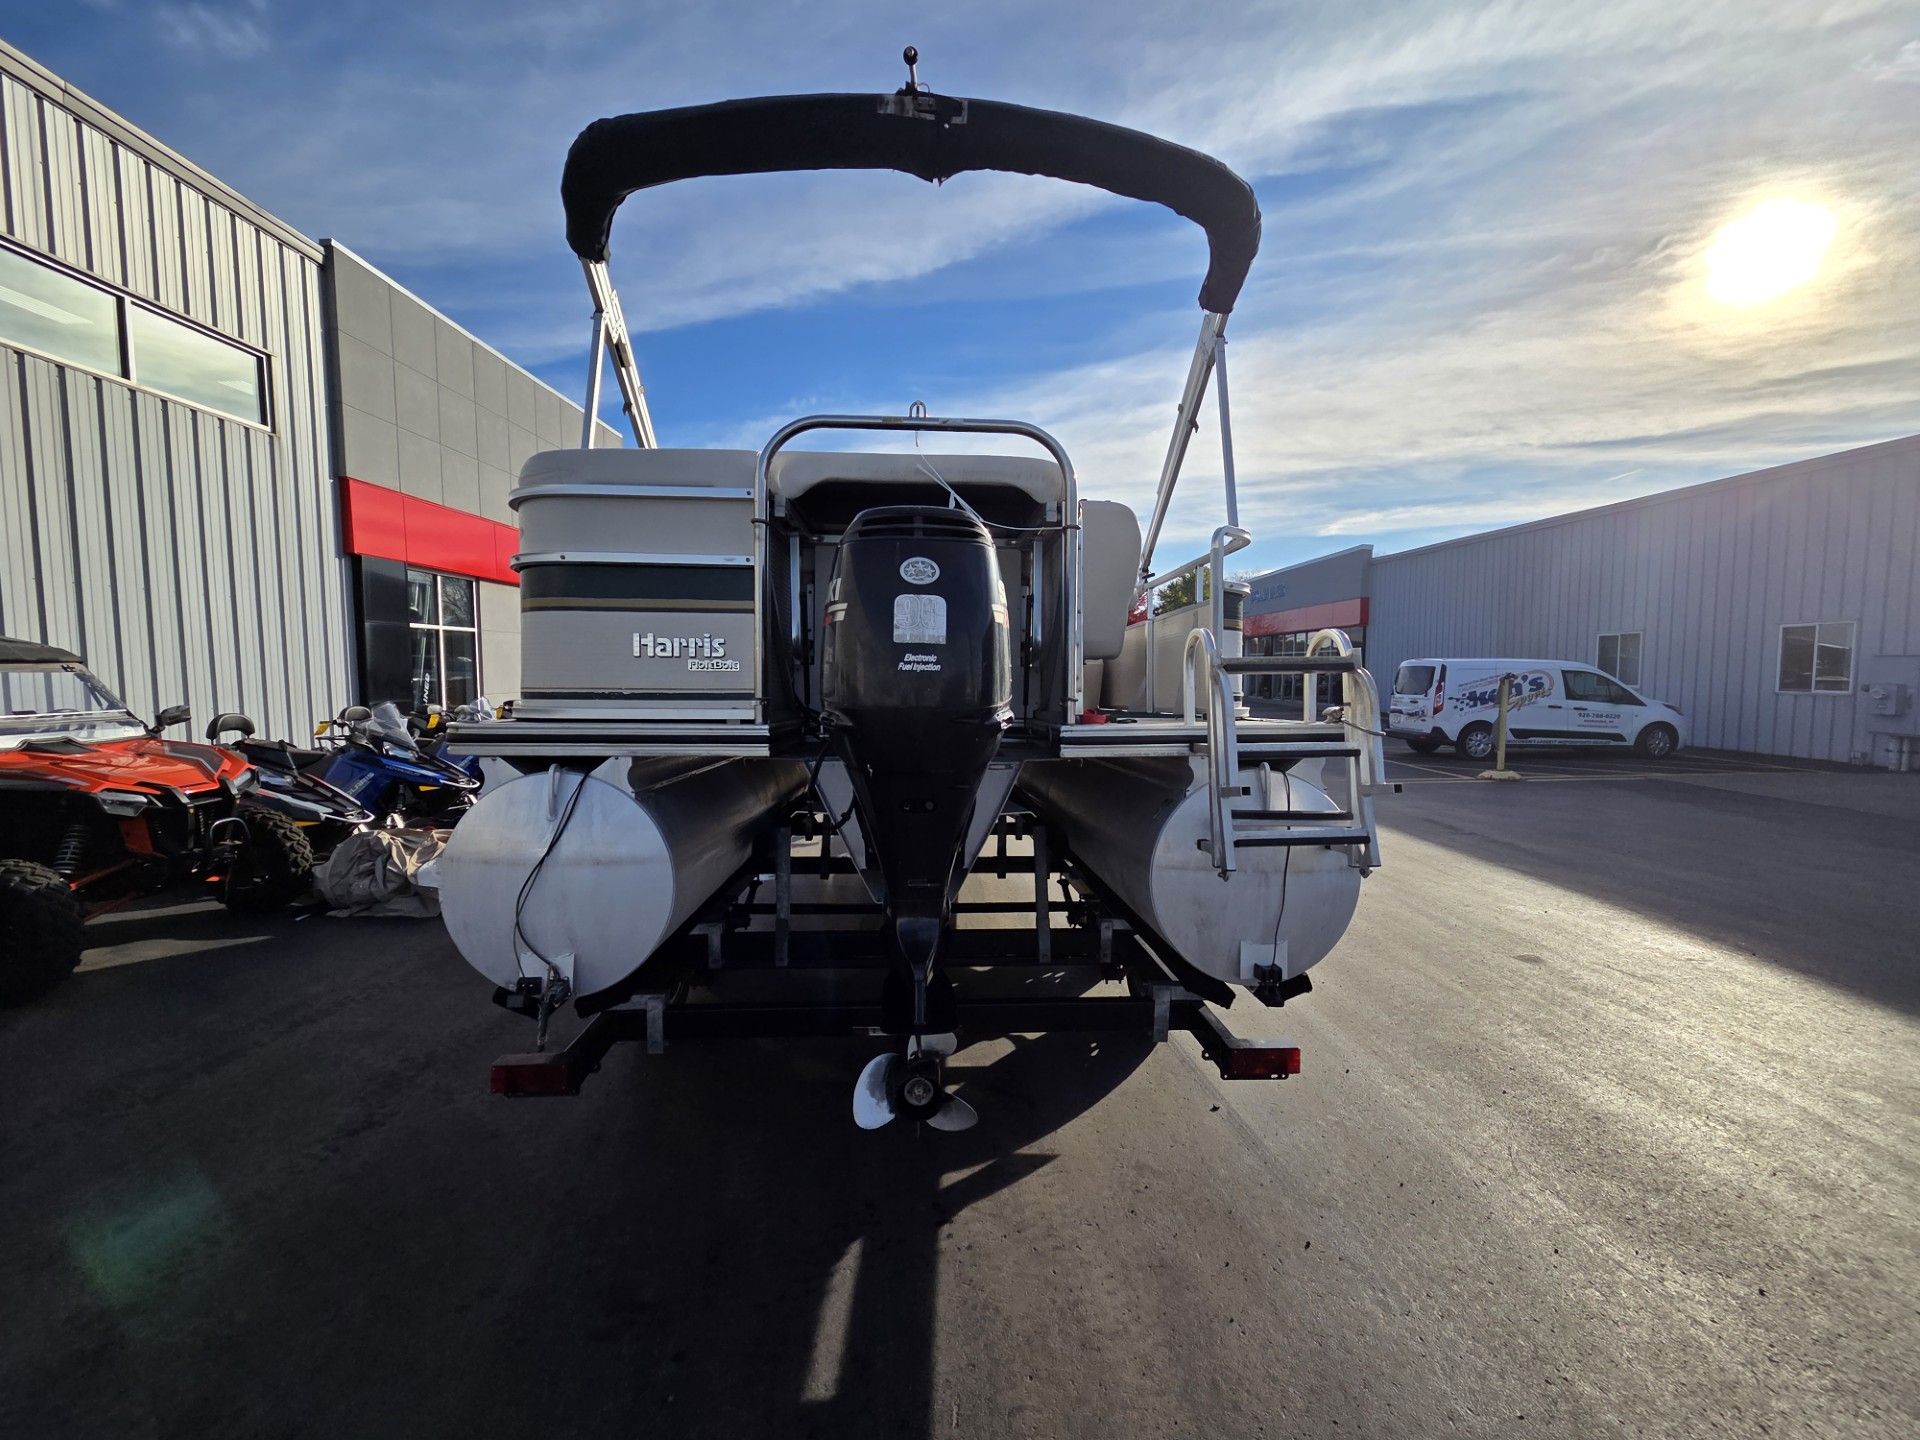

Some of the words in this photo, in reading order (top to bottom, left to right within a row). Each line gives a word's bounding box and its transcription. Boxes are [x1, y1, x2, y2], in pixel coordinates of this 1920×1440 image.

[633, 633, 725, 658] Harris
[904, 653, 937, 662] Electronic
[898, 662, 913, 671] Fuel
[914, 662, 941, 672] Injection
